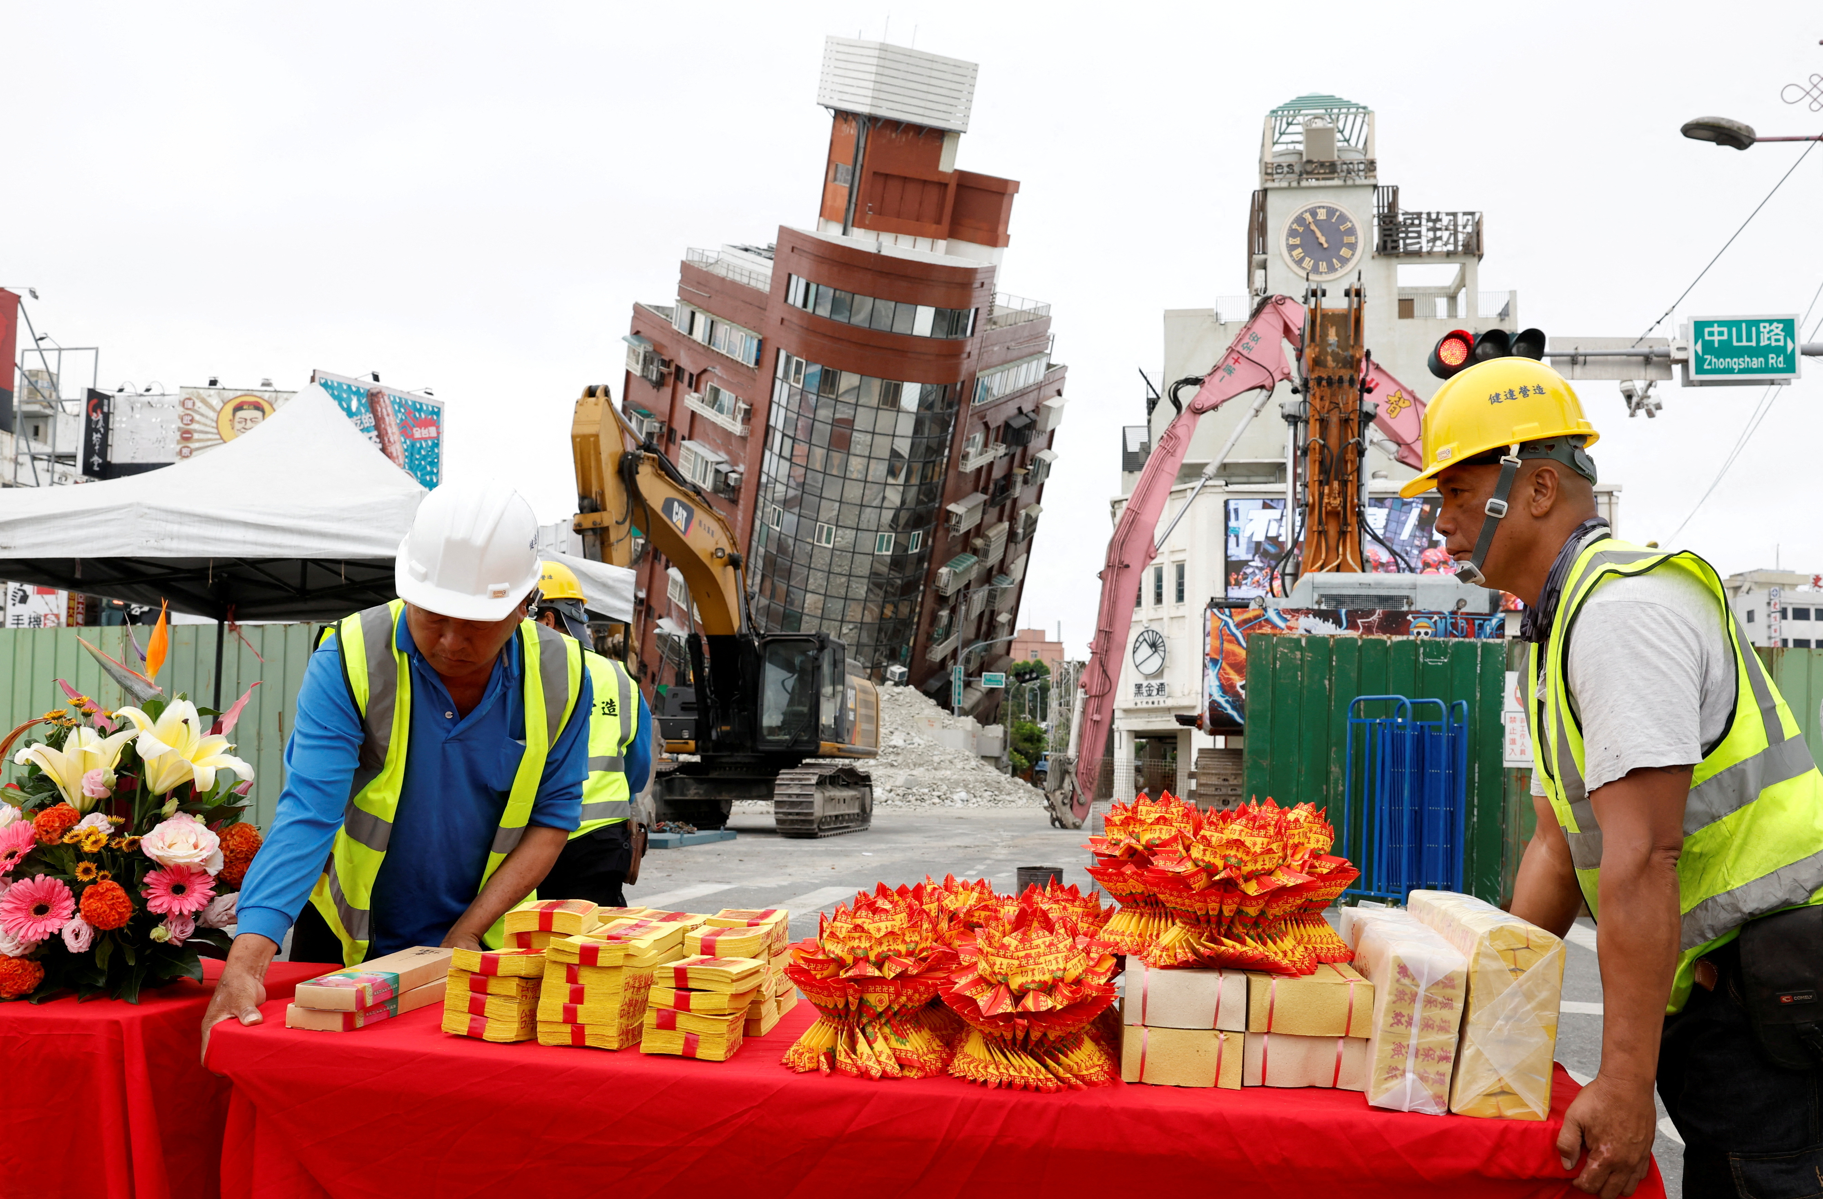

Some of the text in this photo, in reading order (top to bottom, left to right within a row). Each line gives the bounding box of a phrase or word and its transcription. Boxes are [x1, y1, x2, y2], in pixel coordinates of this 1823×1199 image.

[1704, 322, 1785, 347] 中山路
[1703, 354, 1787, 373] Zhongshan Rd.
[672, 500, 687, 532] CAT
[1134, 682, 1166, 697] 黑金通
[1509, 716, 1517, 756] 禁止進入
